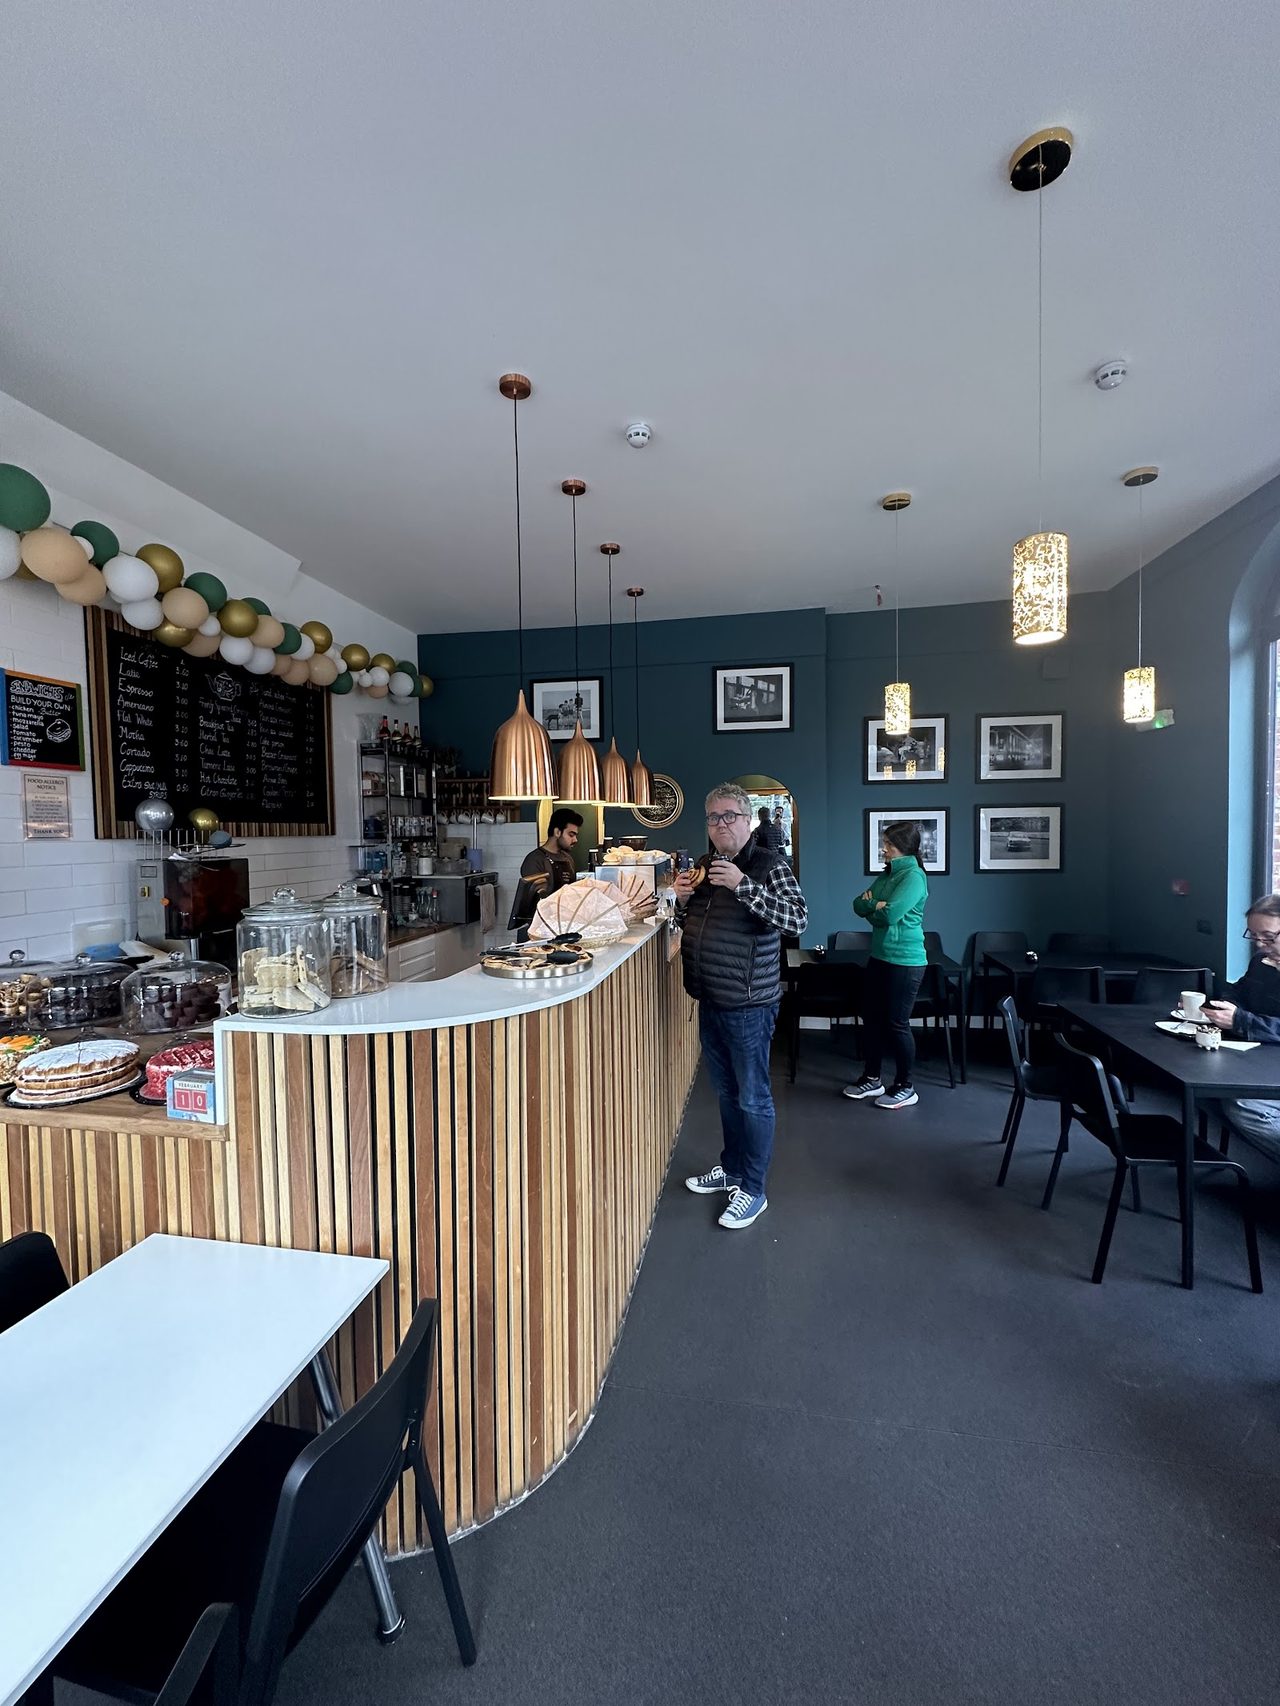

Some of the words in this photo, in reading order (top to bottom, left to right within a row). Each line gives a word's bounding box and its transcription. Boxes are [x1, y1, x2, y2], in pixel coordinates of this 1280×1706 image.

[138, 652, 158, 669] Coffee
[119, 662, 140, 678] Latte
[10, 680, 64, 702] SANDWICHES
[118, 677, 153, 697] Espresso
[11, 694, 31, 705] BUILD
[32, 698, 53, 709] YOUR
[54, 702, 71, 711] OWN
[12, 705, 34, 713] chicken
[117, 694, 155, 712] Americano
[12, 718, 45, 726] mozzarella
[27, 713, 44, 722] mayo
[117, 709, 132, 723] Flat
[135, 713, 153, 727] White
[13, 729, 36, 737] tomato
[13, 735, 43, 744] cucumber
[118, 725, 145, 741] Mocha
[120, 742, 151, 757] Cortado
[120, 758, 155, 776] Cappuccino
[121, 774, 142, 789] Extra
